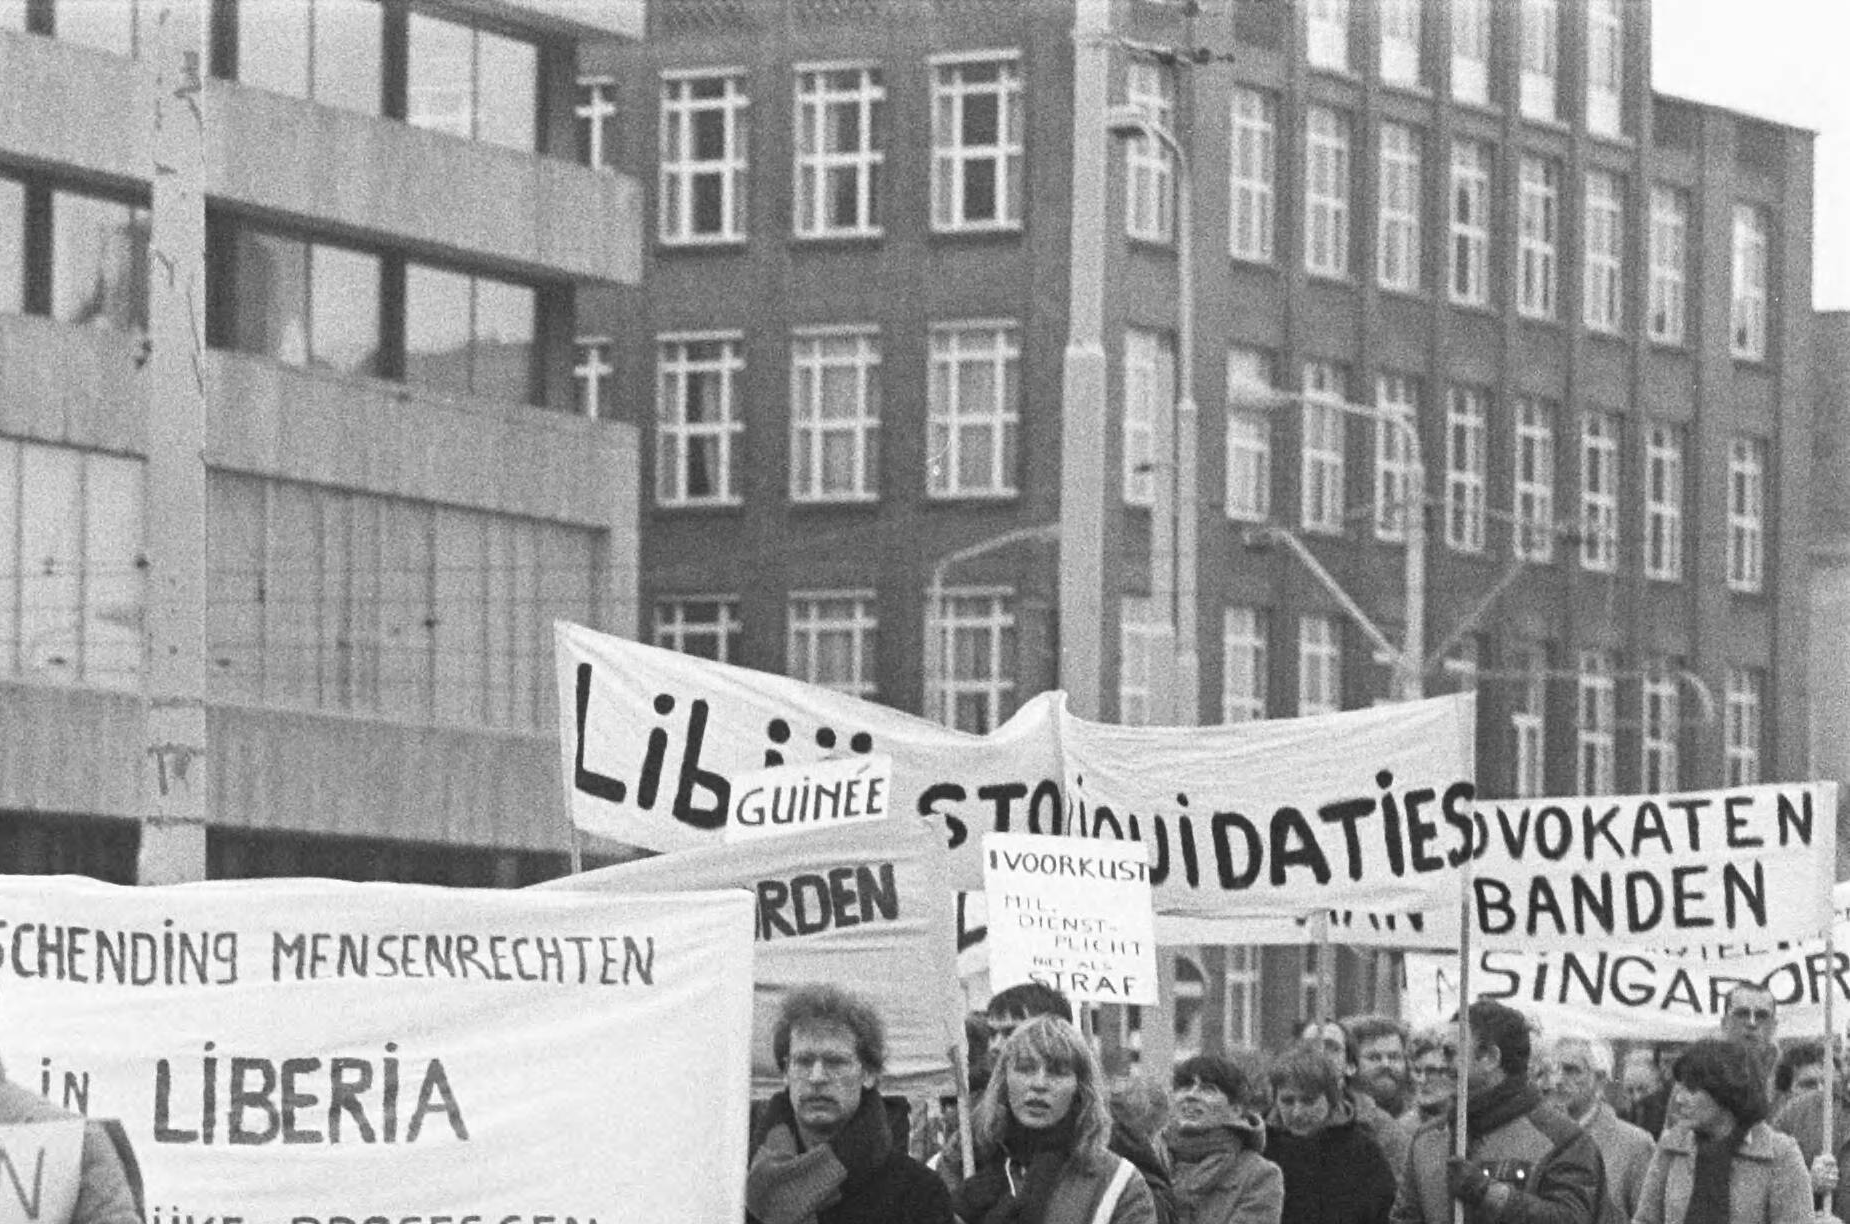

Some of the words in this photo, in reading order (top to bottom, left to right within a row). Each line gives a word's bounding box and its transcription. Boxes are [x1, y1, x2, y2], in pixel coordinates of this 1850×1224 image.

[917, 779, 1062, 849] STO
[754, 863, 898, 941] RDEN
[1473, 859, 1768, 937] BANDEN
[272, 930, 655, 985] MENSENRECHTEN
[1055, 935, 1140, 956] PLICHT
[1028, 970, 1135, 996] STRAF
